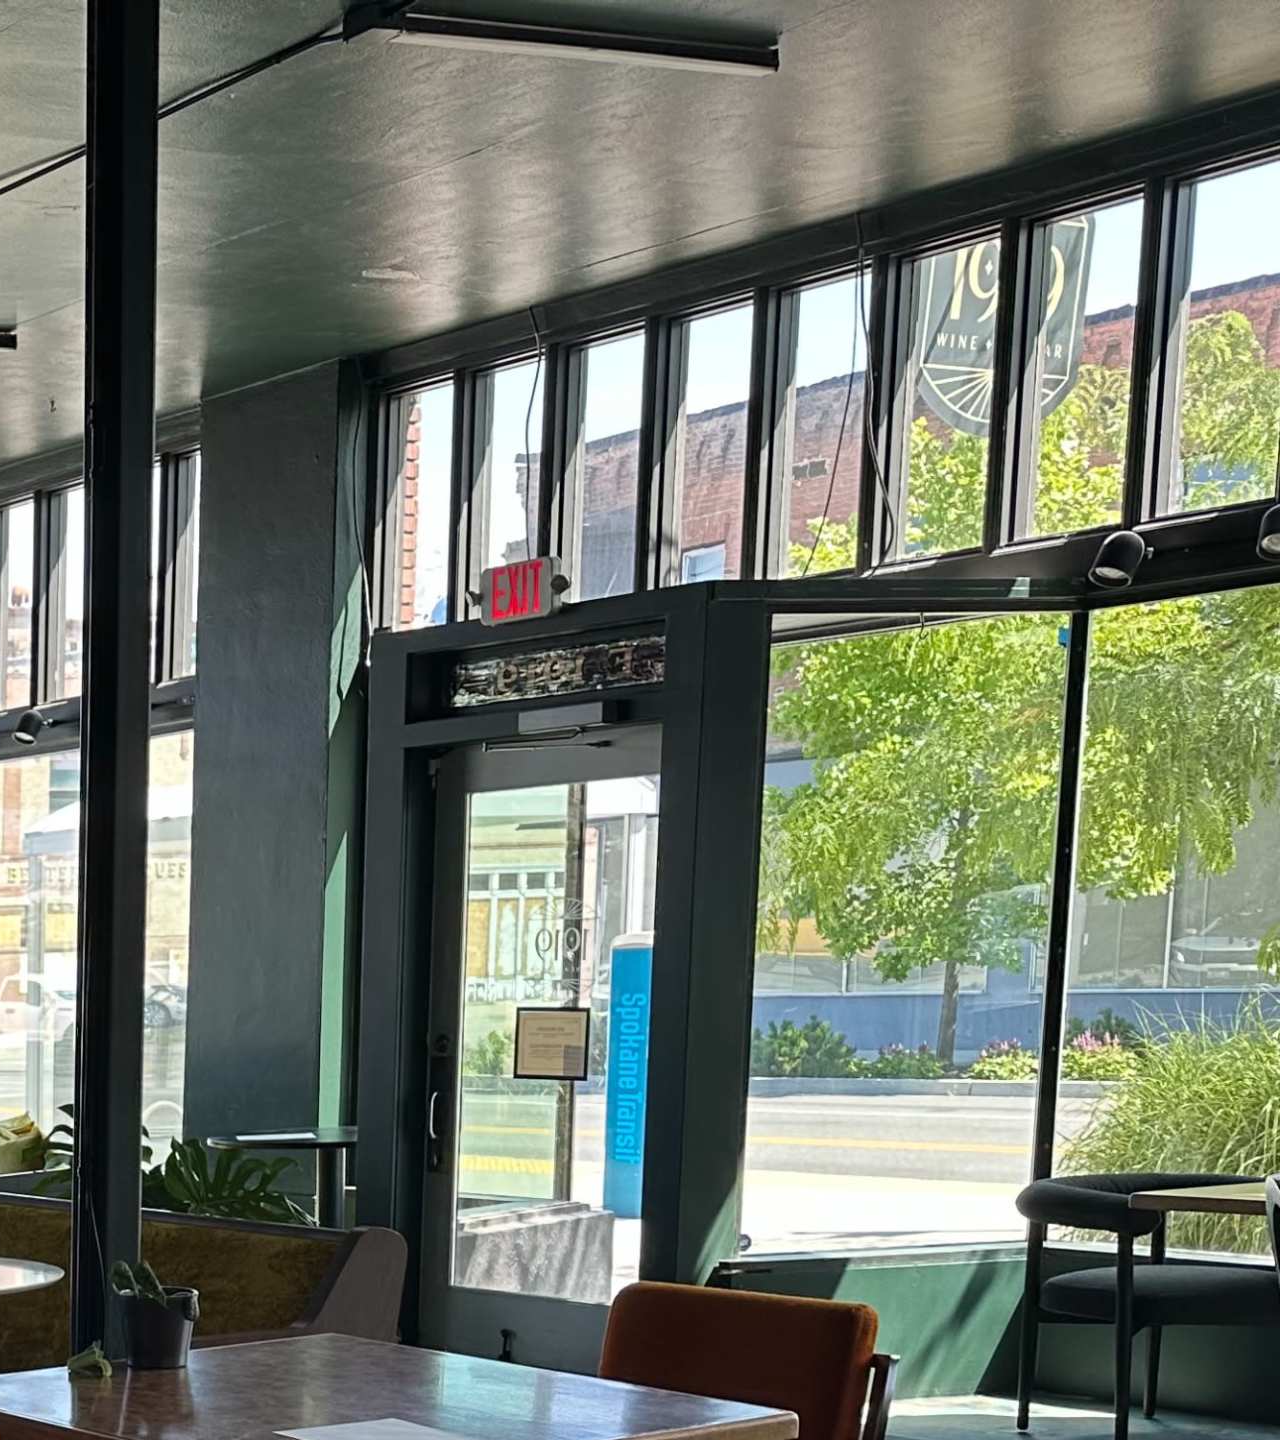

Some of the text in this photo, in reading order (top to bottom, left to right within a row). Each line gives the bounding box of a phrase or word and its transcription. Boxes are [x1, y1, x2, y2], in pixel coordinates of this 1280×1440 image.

[936, 332, 979, 351] WINE
[491, 560, 544, 620] EXIT
[614, 992, 646, 1164] Spokane Transit
